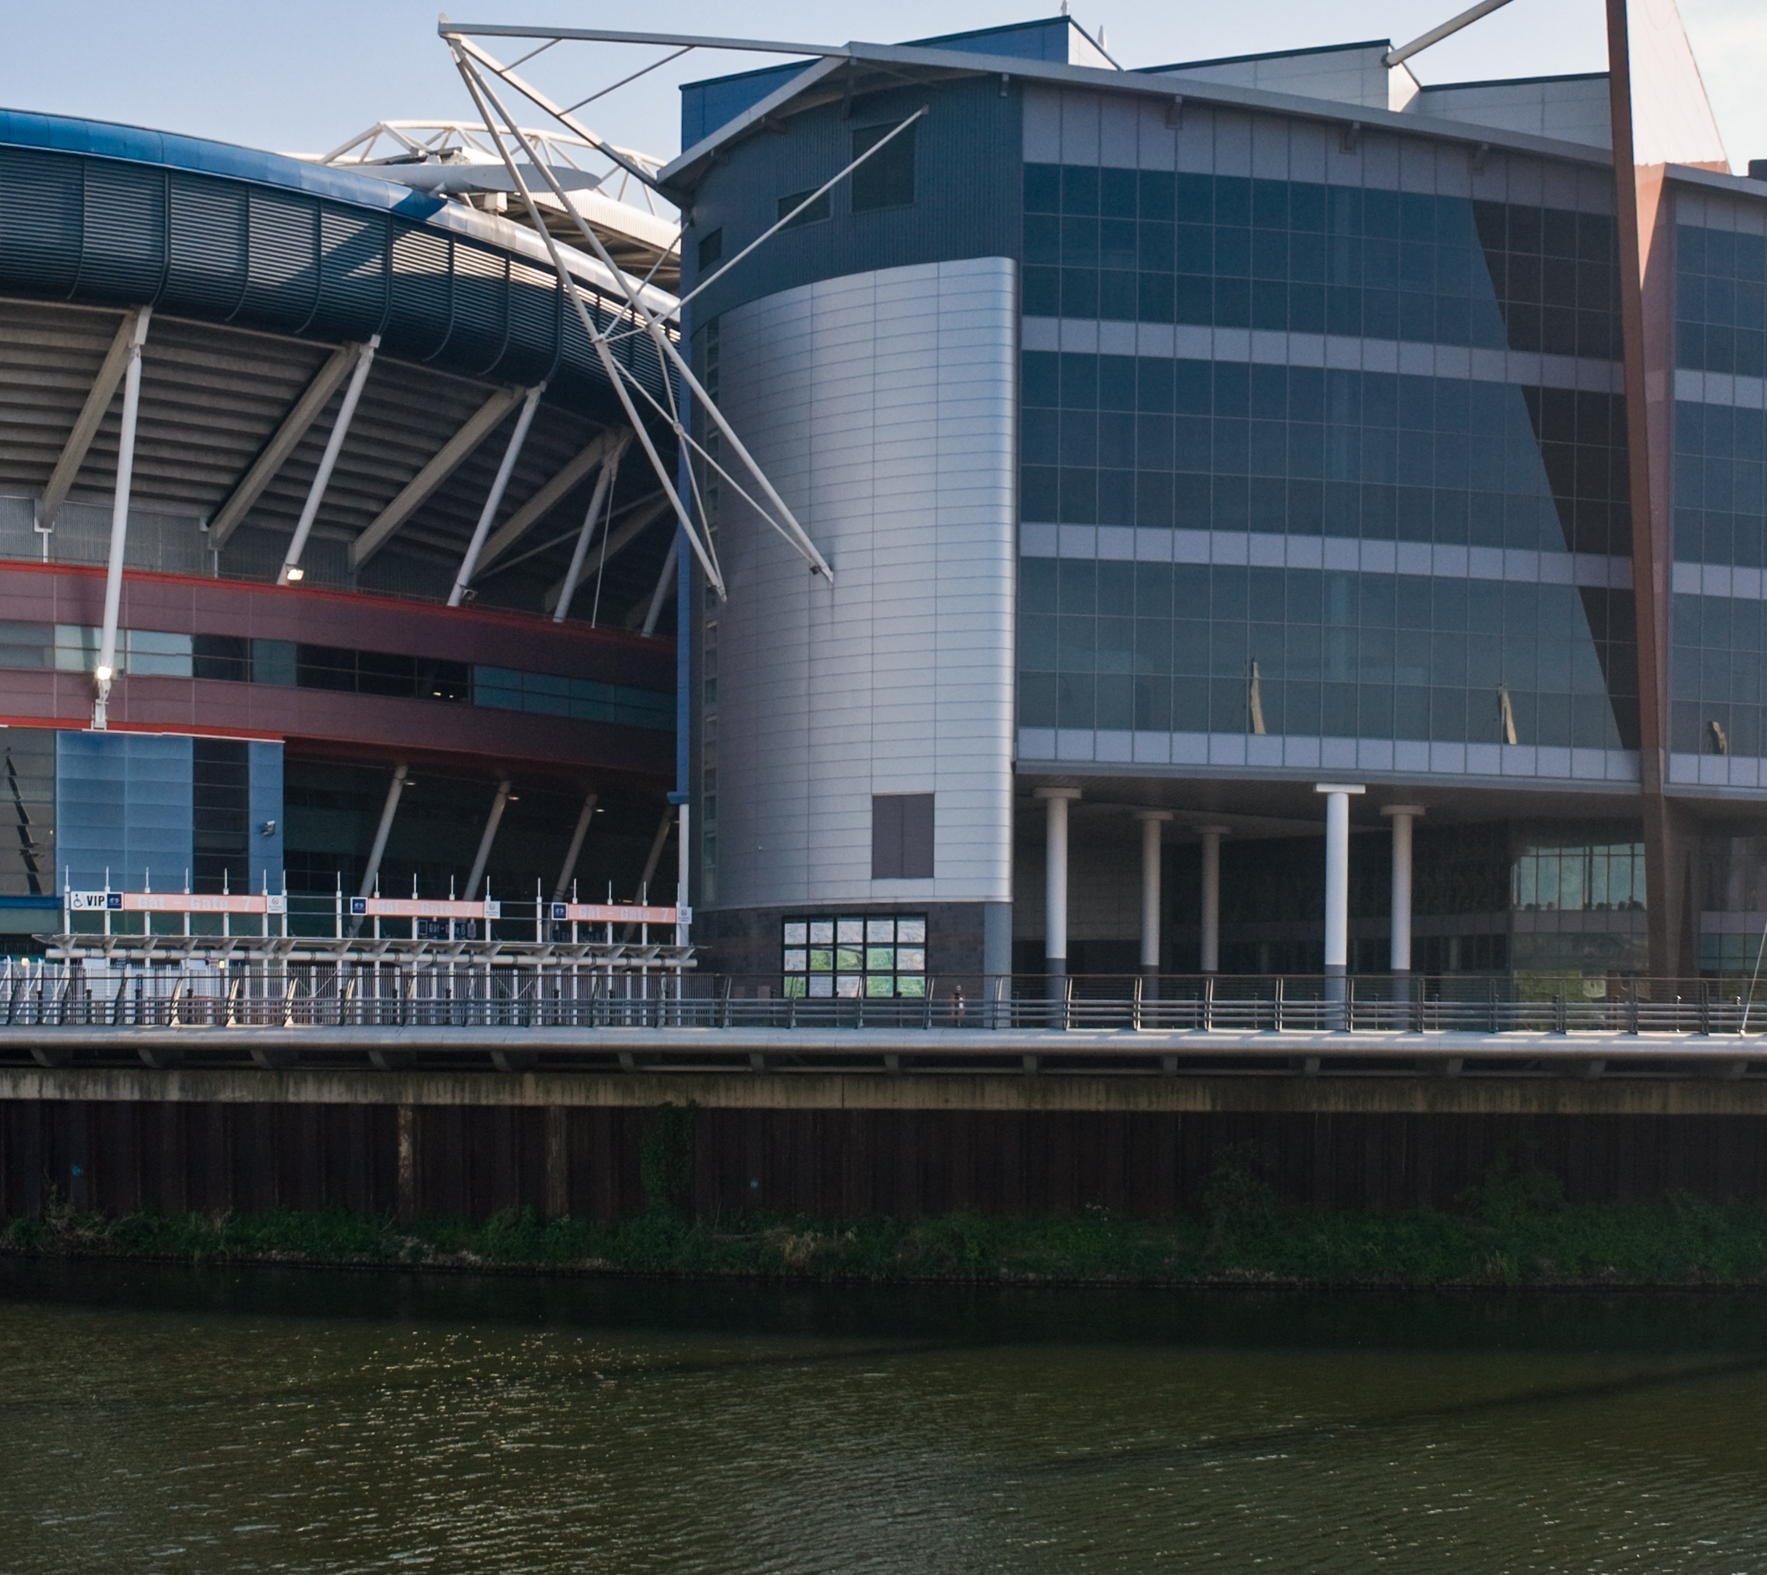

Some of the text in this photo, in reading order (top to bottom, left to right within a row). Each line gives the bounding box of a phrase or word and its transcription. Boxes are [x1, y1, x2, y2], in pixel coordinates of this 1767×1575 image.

[87, 895, 105, 907] VIP
[190, 896, 228, 910] Gate
[242, 897, 252, 912] 7
[620, 908, 650, 921] Gate
[660, 908, 669, 922] 7
